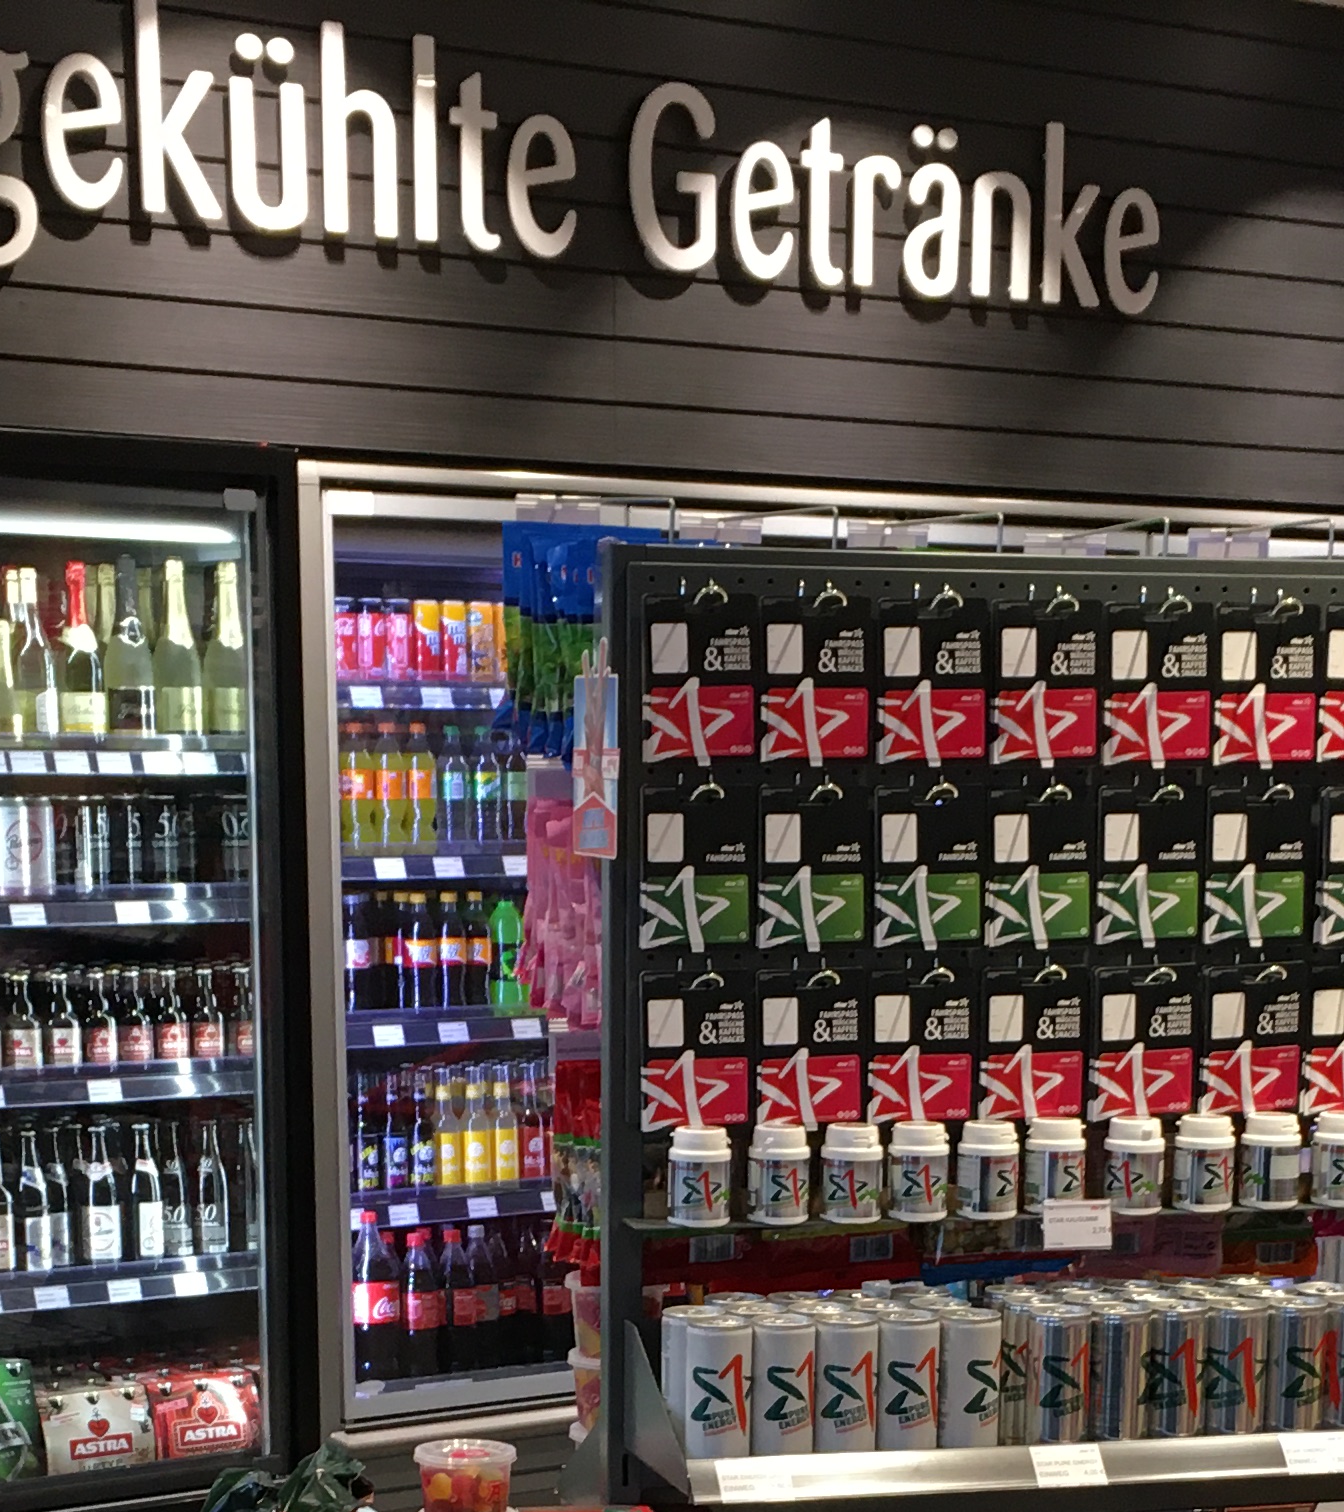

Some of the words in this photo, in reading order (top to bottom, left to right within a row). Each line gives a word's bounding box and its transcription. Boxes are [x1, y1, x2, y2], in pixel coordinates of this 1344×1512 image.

[628, 81, 1159, 315] Getränke
[183, 1424, 237, 1442] ASTRA
[74, 1438, 129, 1455] ASTRA
